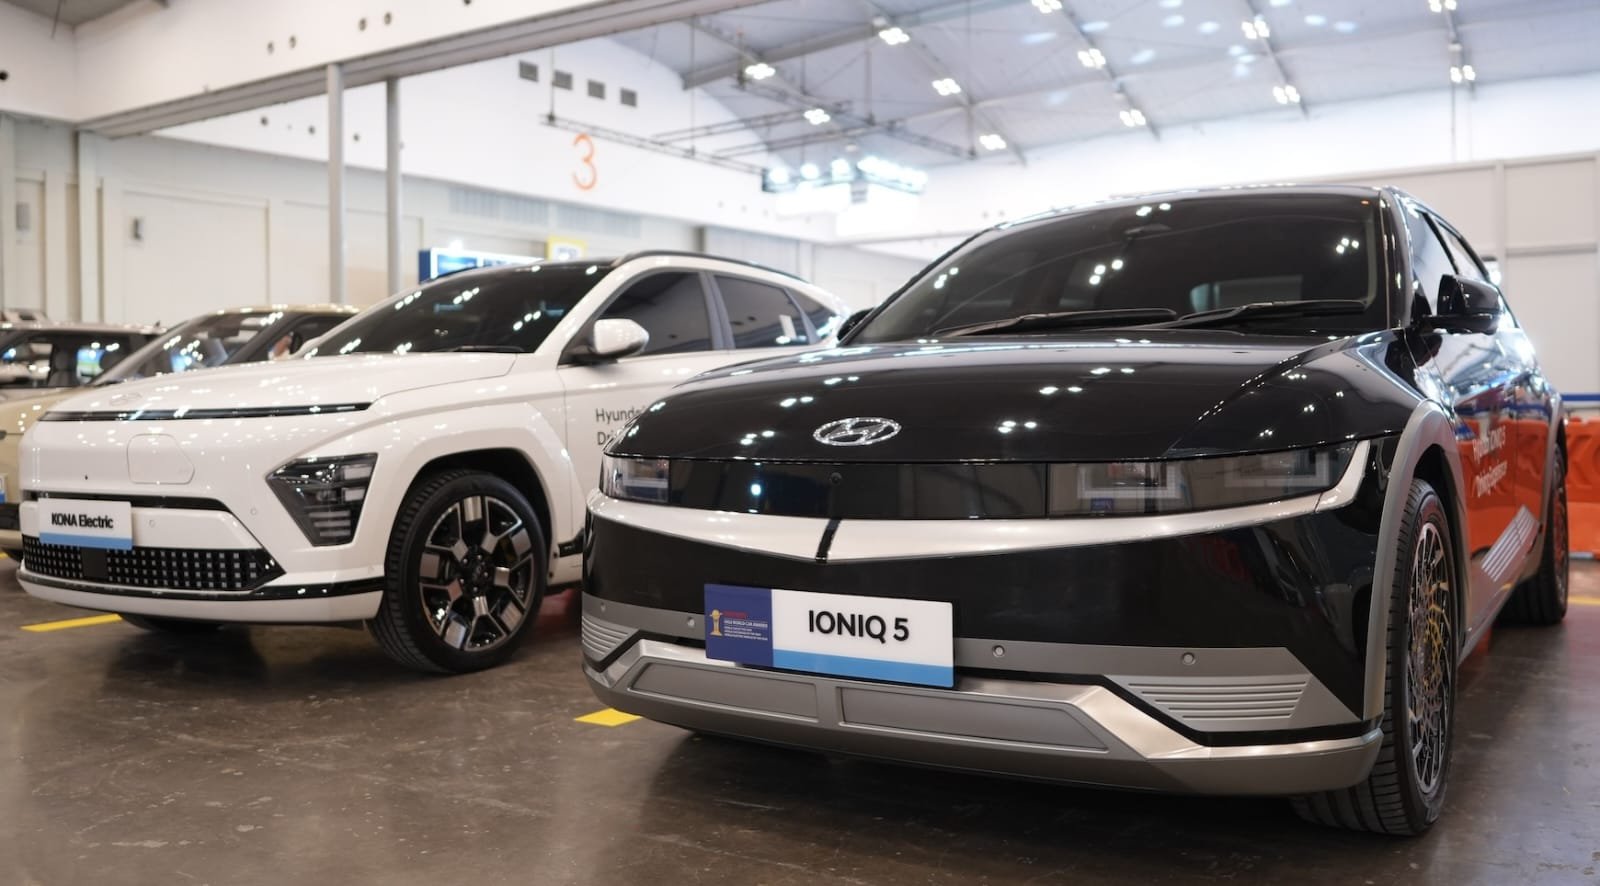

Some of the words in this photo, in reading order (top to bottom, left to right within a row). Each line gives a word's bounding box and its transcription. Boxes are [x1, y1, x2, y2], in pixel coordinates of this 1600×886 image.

[571, 132, 597, 191] 3
[51, 513, 77, 527] KONA
[79, 514, 113, 529] Electric
[808, 609, 886, 644] IONIQ
[893, 617, 909, 641] 5
